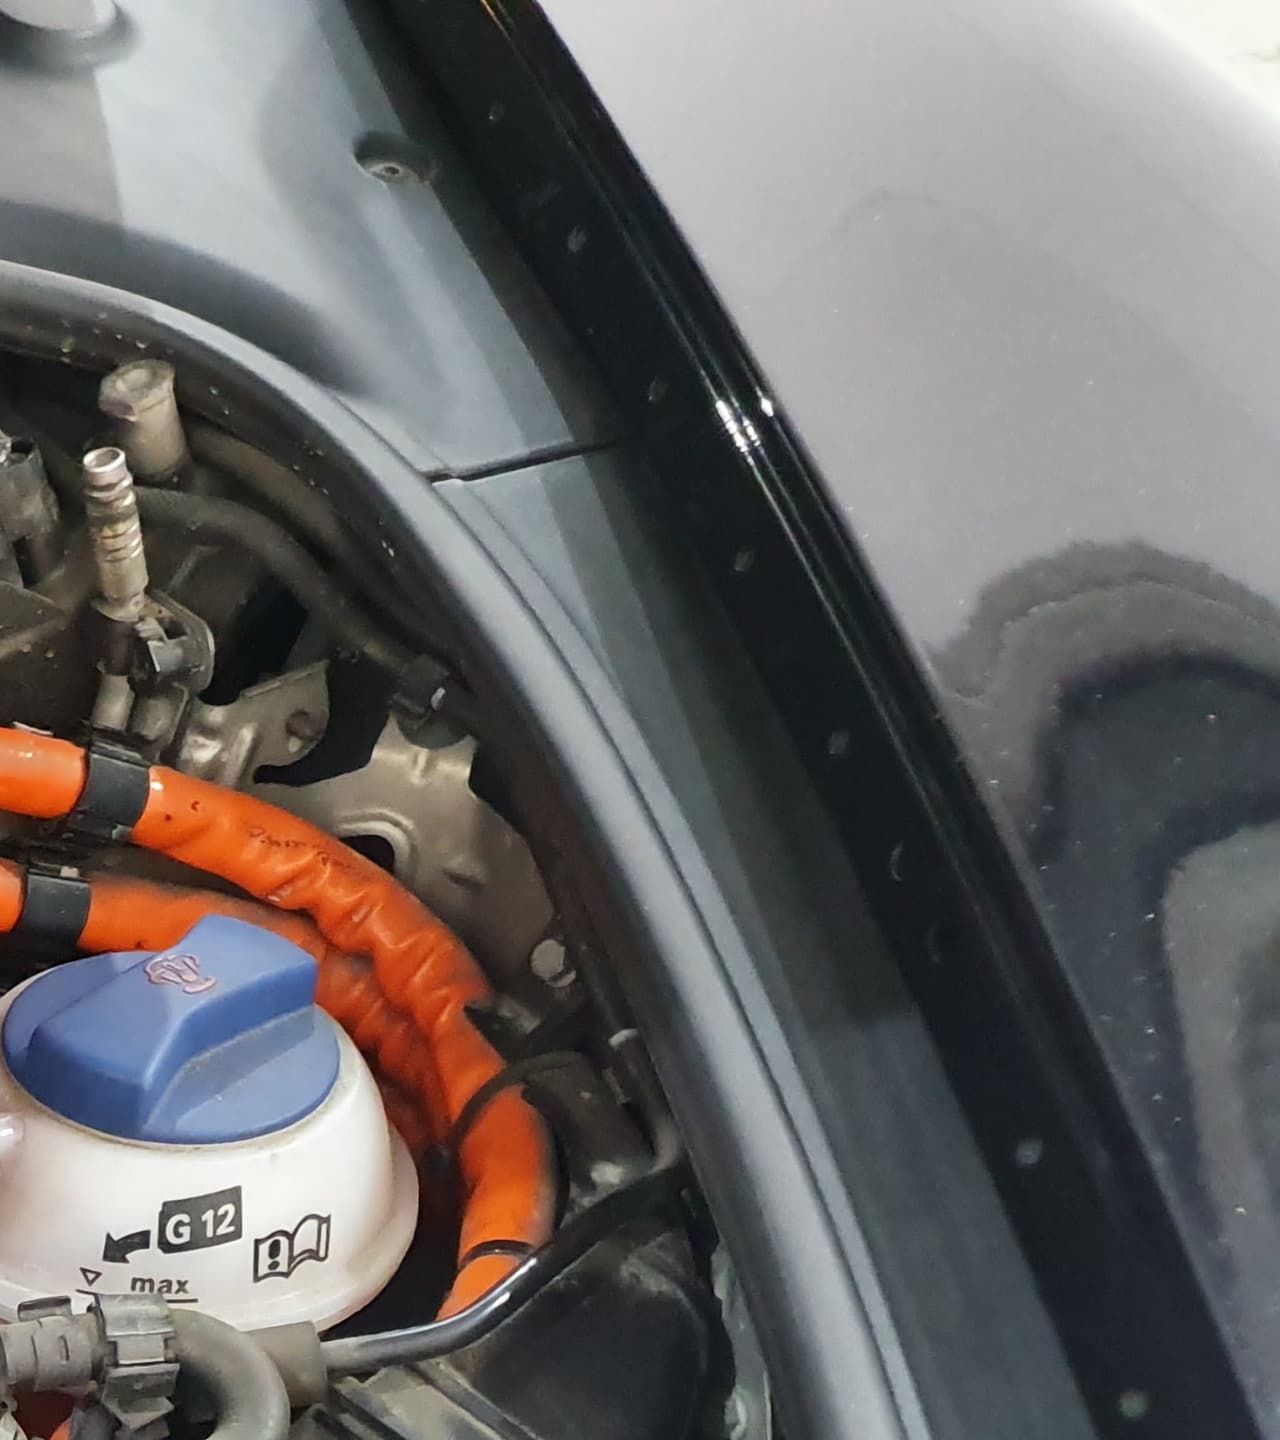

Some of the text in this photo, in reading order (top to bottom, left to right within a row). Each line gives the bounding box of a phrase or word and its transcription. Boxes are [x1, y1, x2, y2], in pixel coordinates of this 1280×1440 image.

[166, 1203, 236, 1245] G 12
[130, 1277, 189, 1294] max
